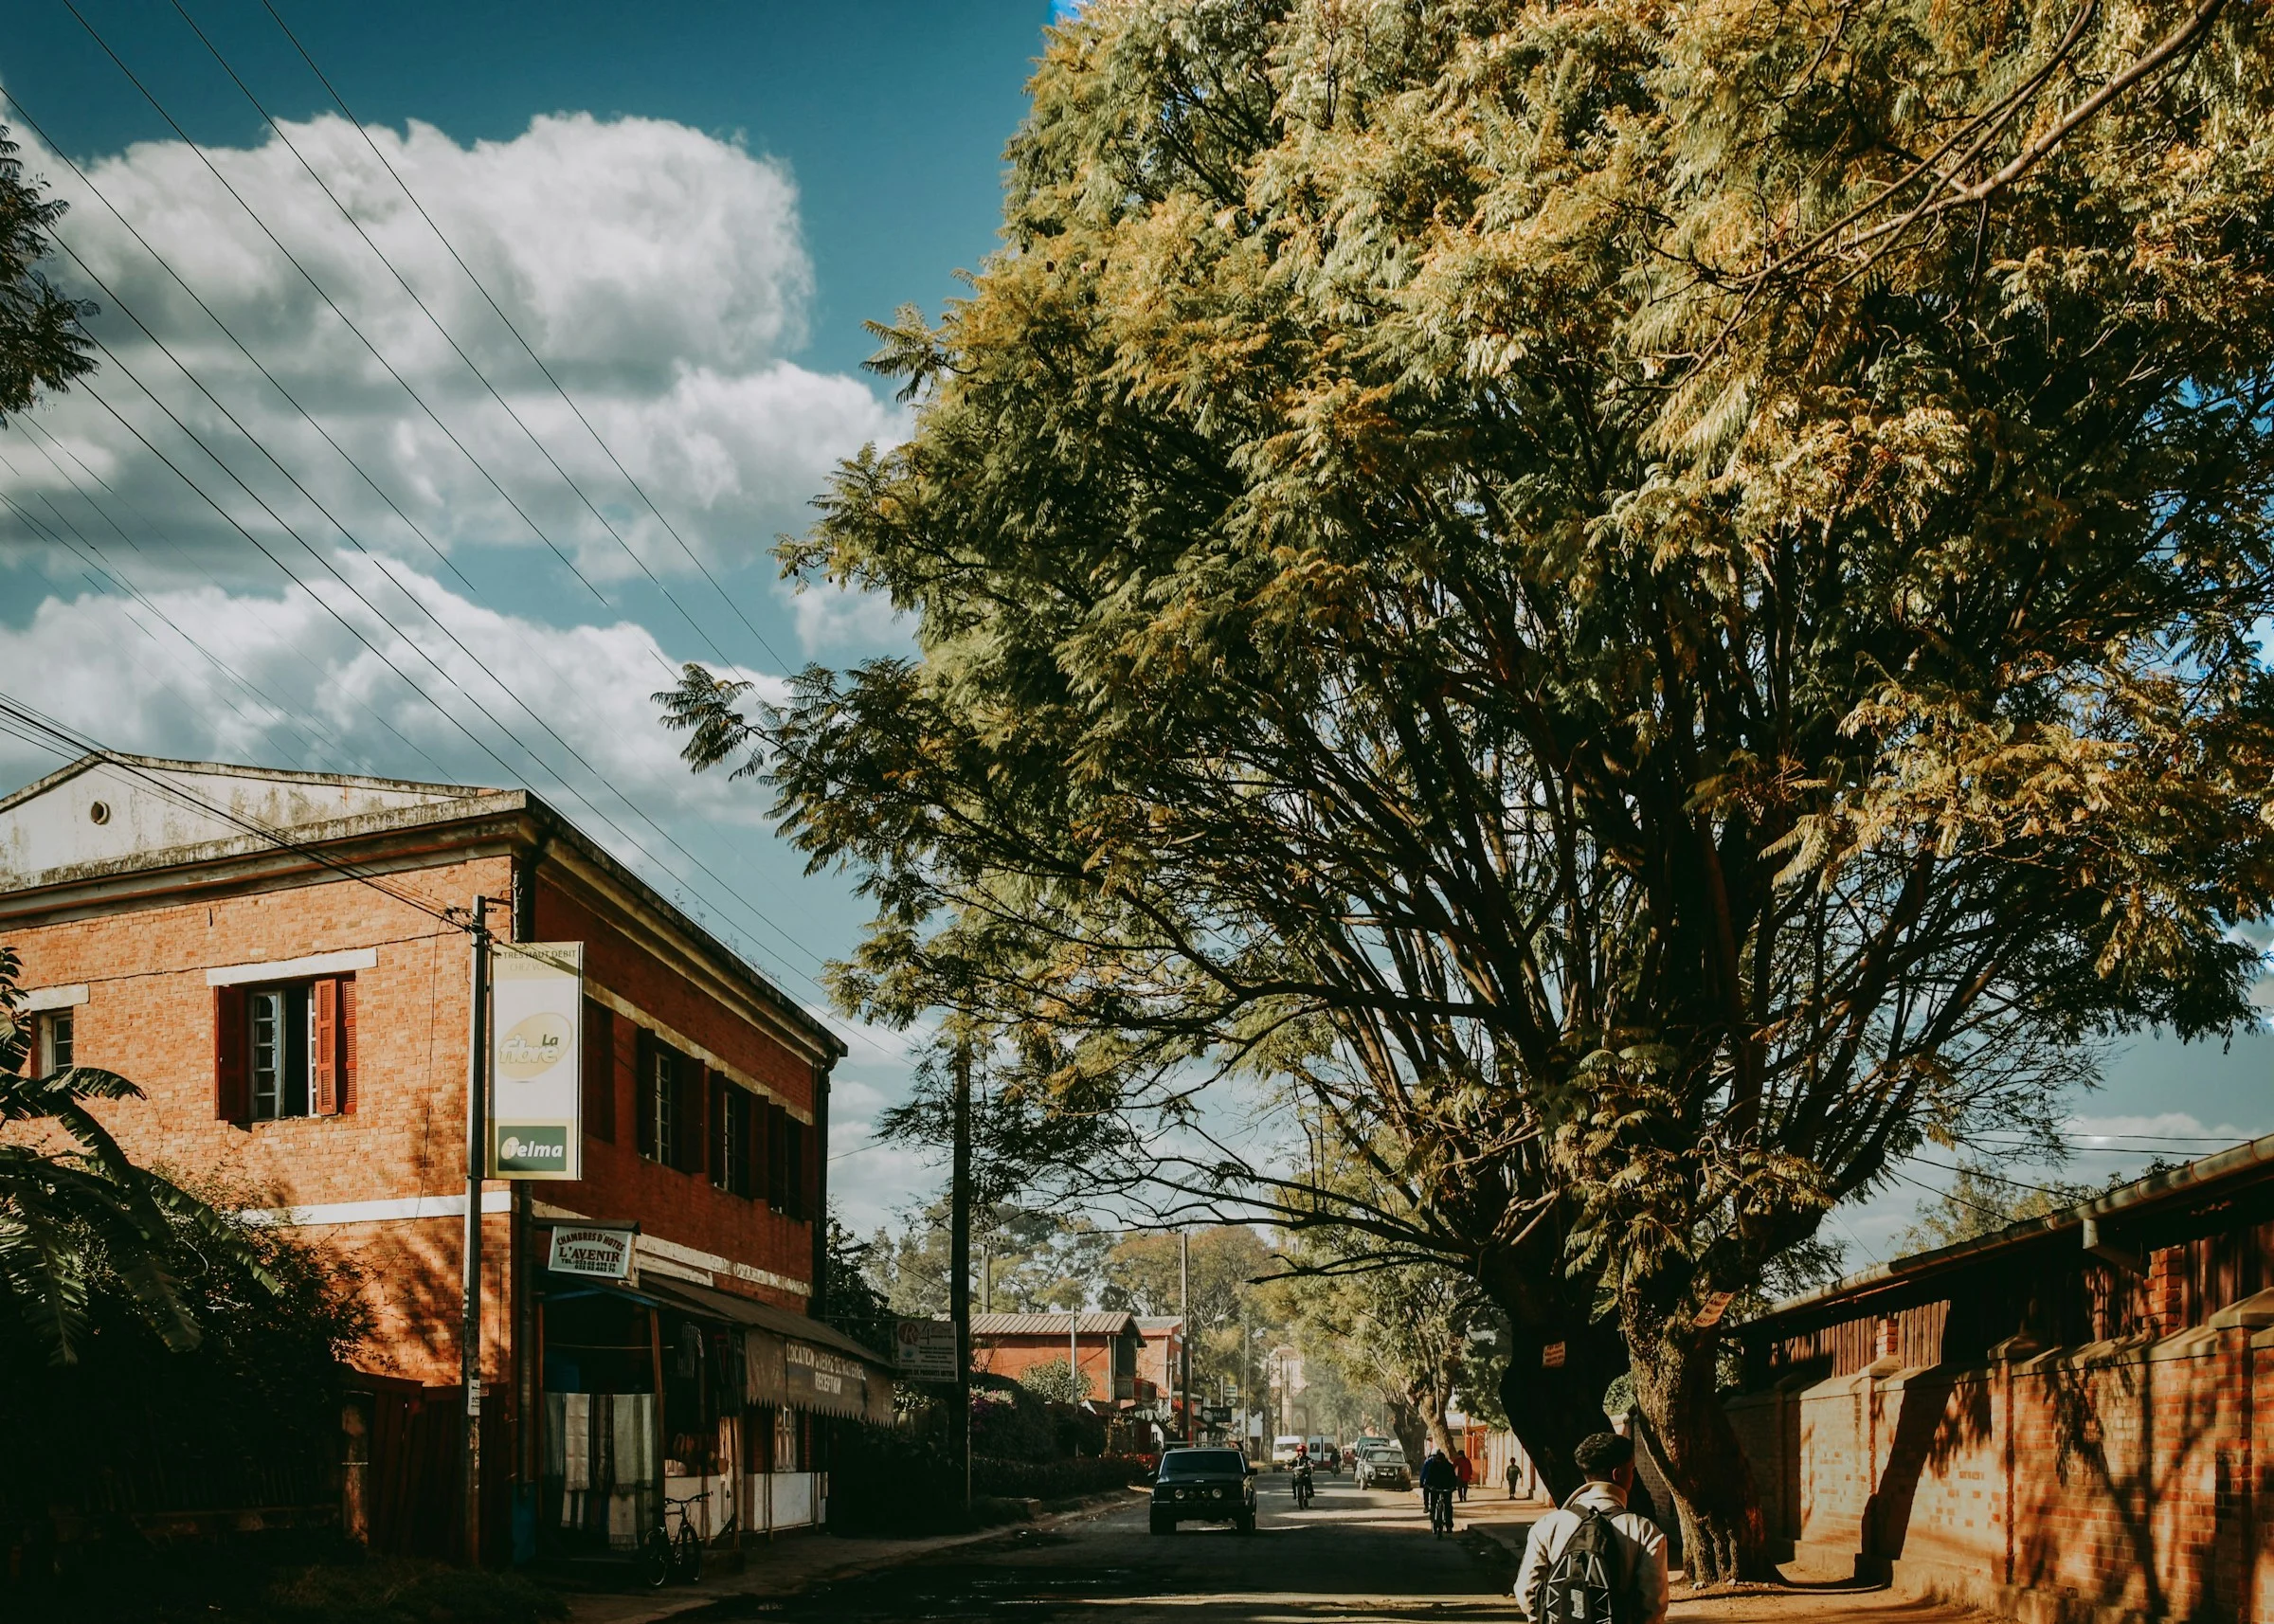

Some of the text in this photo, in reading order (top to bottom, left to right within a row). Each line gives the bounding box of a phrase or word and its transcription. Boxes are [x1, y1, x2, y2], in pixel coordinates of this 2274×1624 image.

[542, 1034, 559, 1046] La
[499, 1034, 560, 1064] fibre
[507, 1141, 564, 1158] Telma
[556, 1232, 596, 1246] CHAMBRES
[559, 1246, 620, 1263] L'AVENIR
[786, 1343, 815, 1367] LOCATION
[815, 1371, 842, 1396] RECEPTION
